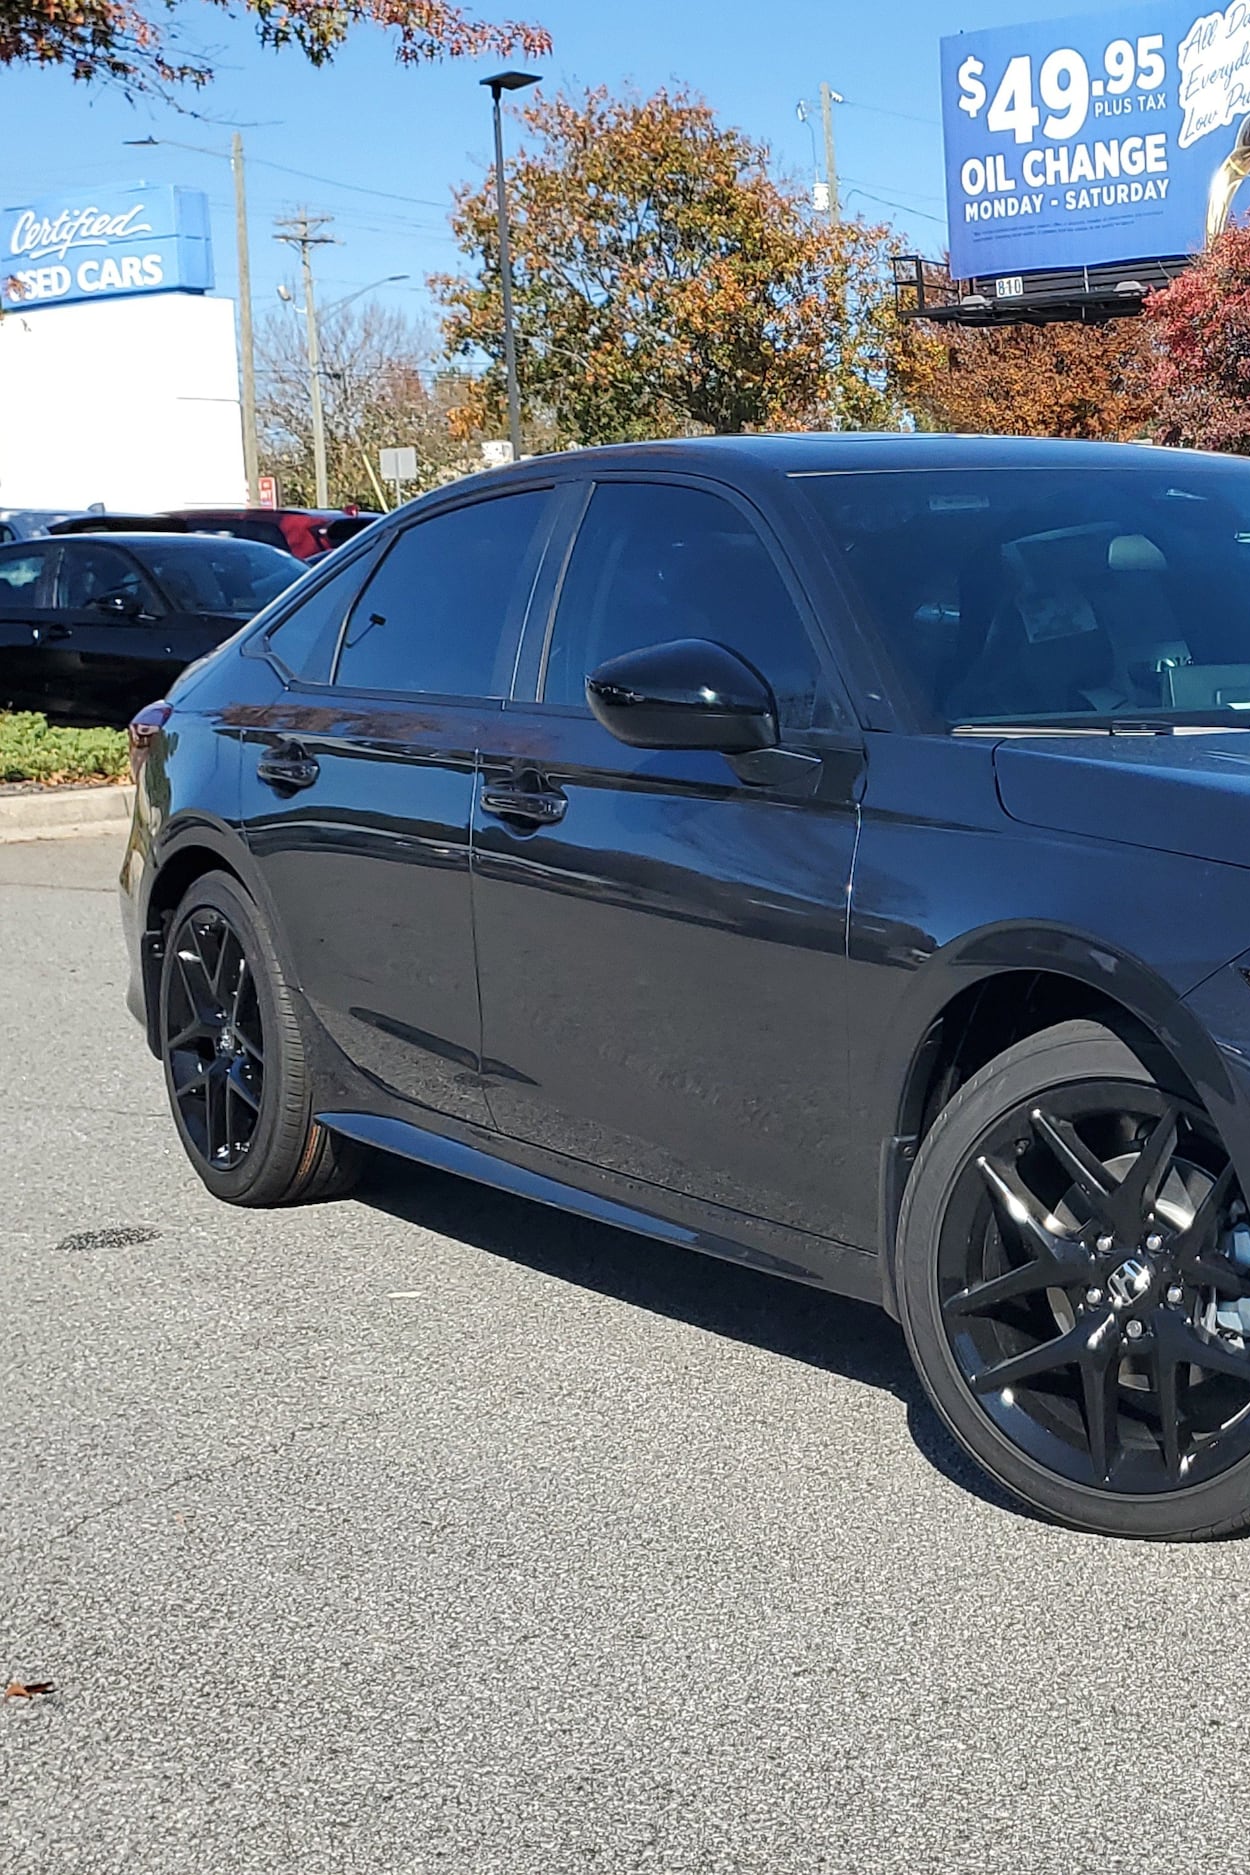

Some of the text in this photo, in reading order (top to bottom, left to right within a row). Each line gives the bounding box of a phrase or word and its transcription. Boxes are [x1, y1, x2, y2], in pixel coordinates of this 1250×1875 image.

[1183, 18, 1220, 64] All
[957, 34, 1167, 145] $49.95
[1093, 92, 1168, 119] PLUS TAX
[1183, 107, 1219, 141] Low
[960, 133, 1168, 196] OIL CHANGE
[965, 194, 1044, 223] MONDAY
[1065, 179, 1170, 211] SATURDAY
[11, 204, 152, 260] Certified
[77, 254, 164, 293] CARS
